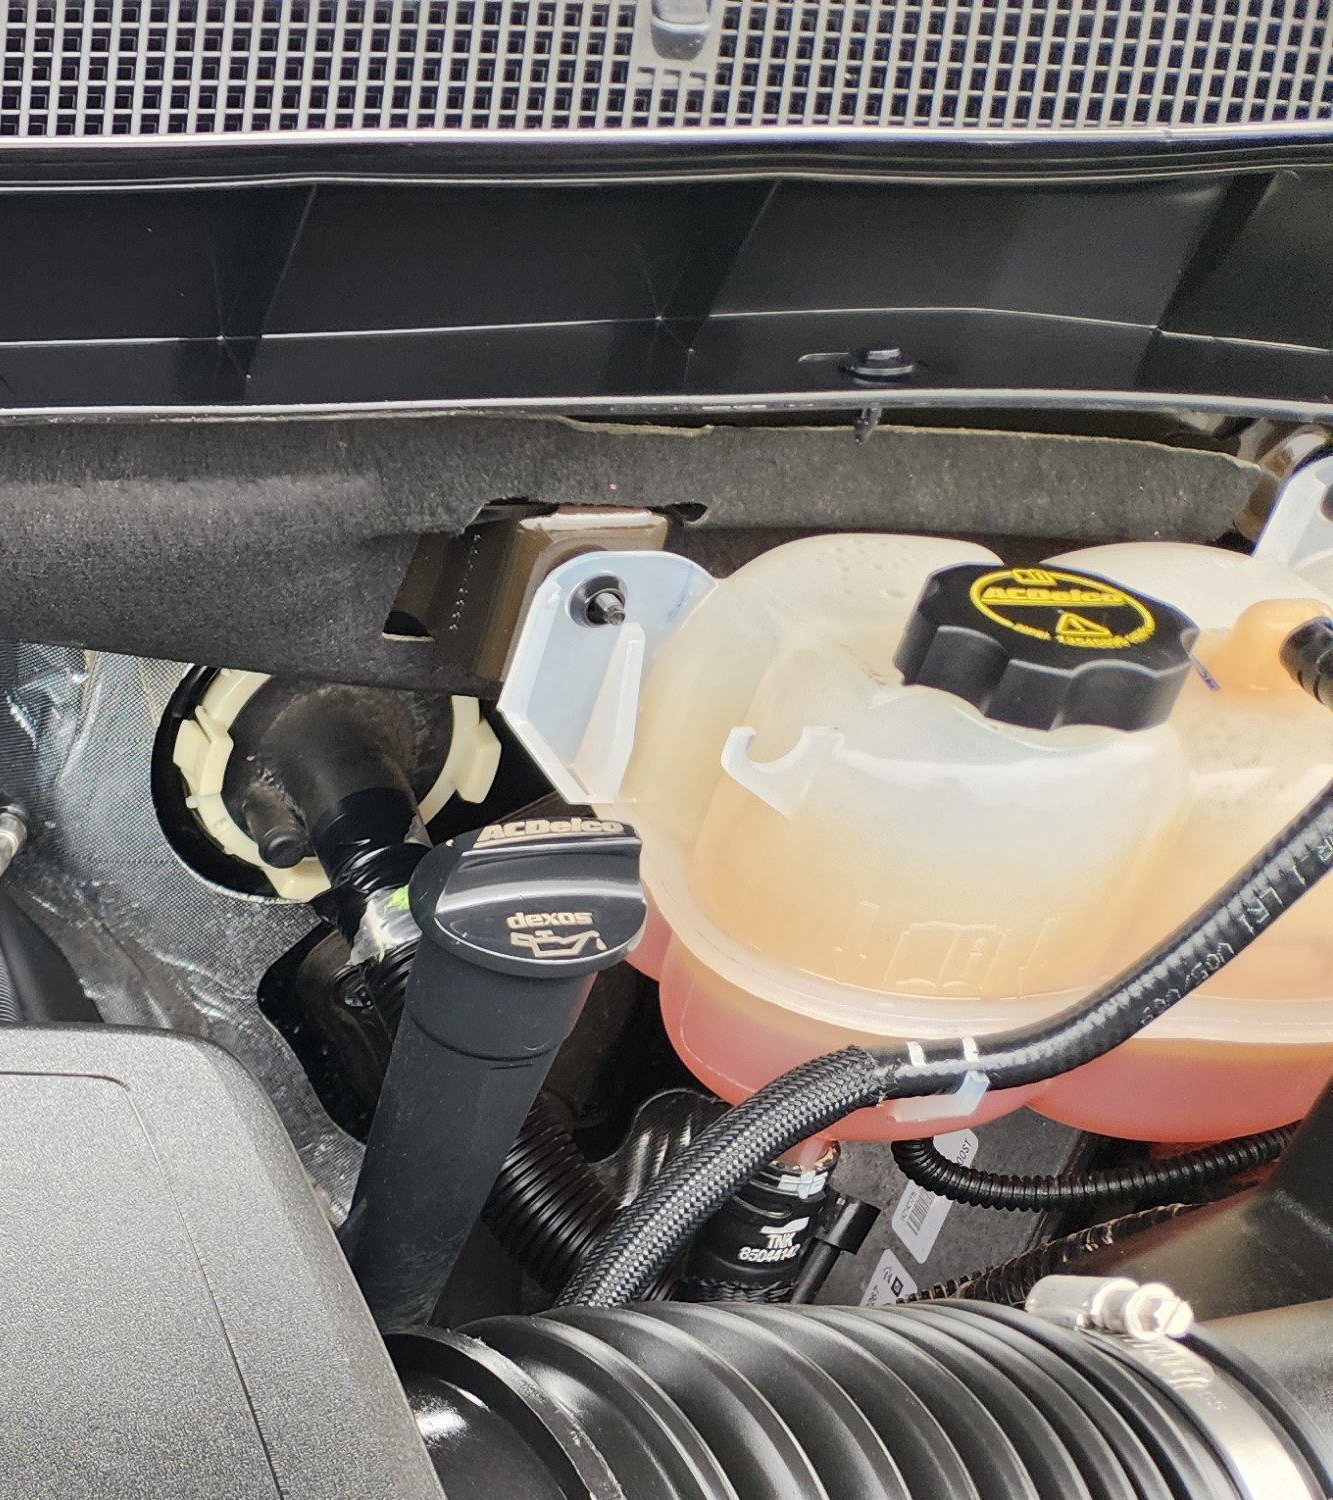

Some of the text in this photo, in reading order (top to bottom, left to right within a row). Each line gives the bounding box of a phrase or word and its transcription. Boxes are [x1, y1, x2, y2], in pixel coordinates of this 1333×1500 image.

[983, 586, 1124, 602] ACDelco
[477, 818, 625, 842] ACDelco
[506, 912, 593, 929] dexos
[956, 1137, 973, 1167] OOST
[766, 1232, 796, 1249] TNK
